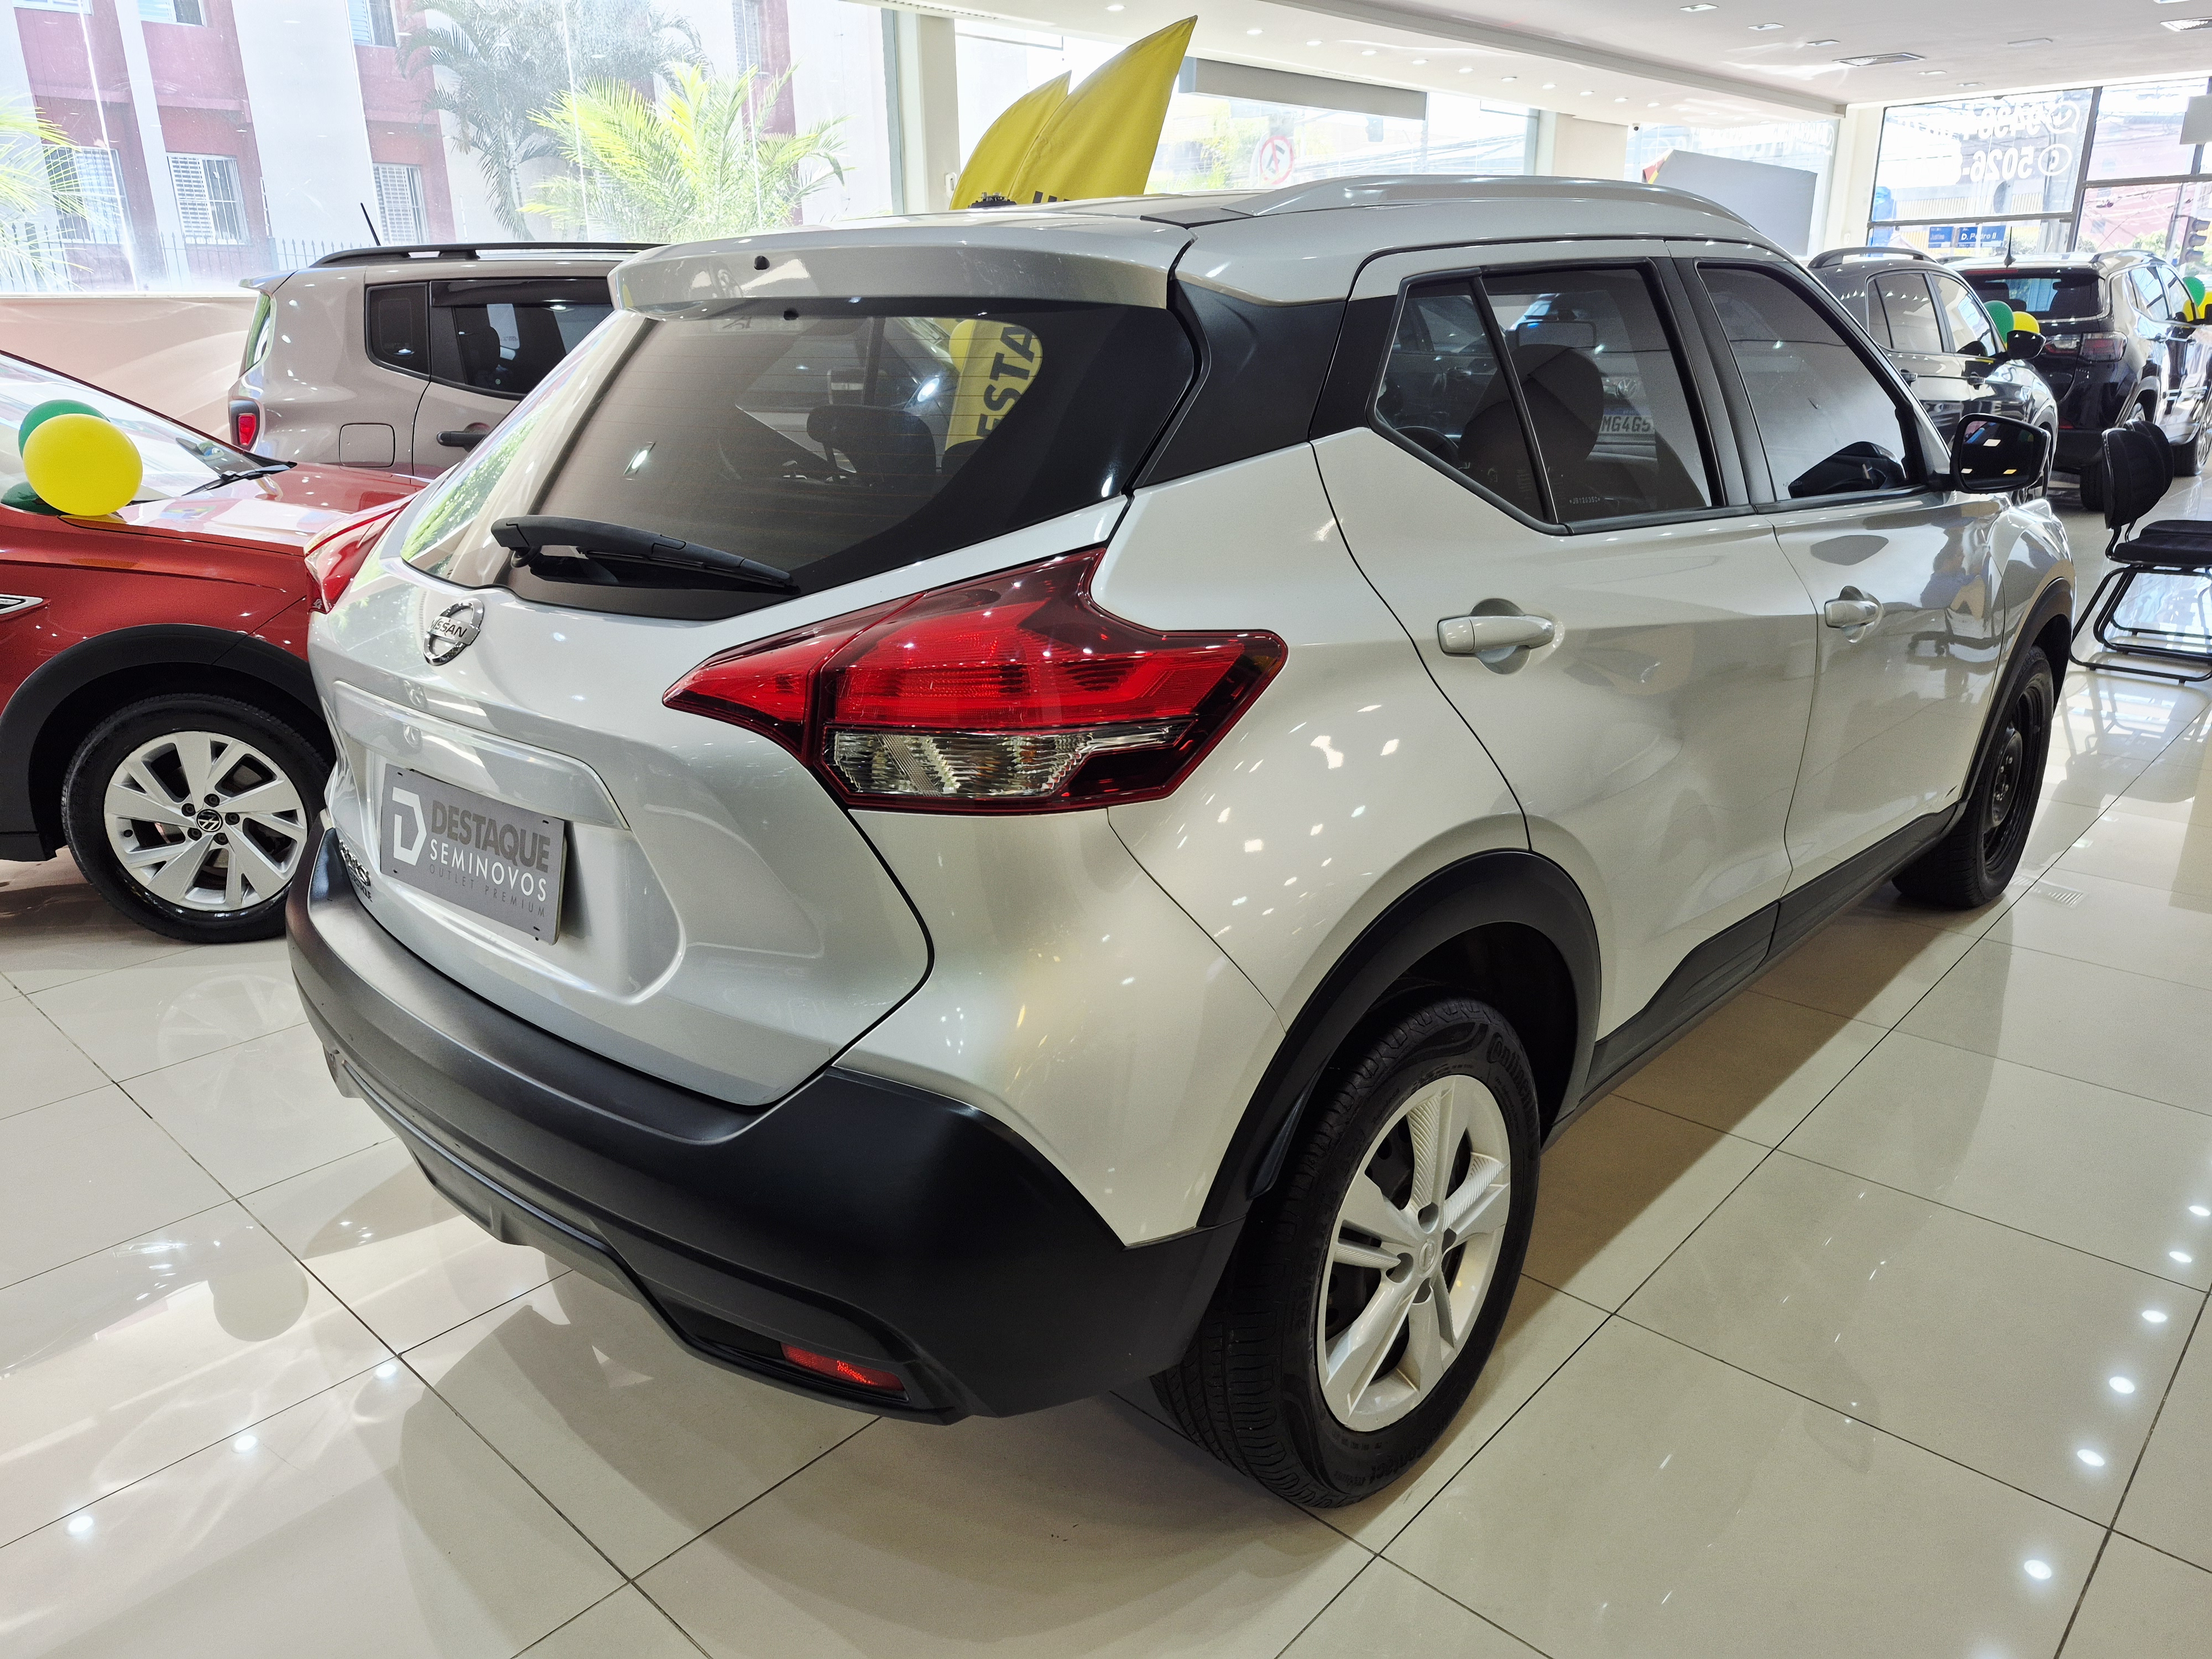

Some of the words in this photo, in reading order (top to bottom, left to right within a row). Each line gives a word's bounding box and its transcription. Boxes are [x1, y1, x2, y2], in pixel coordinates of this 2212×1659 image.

[431, 618, 467, 638] NISSAN
[431, 800, 551, 873] DESTAQUE
[429, 864, 474, 889] OUTLET
[484, 884, 545, 917] PREMIUM
[430, 838, 547, 902] SEMINOVOS
